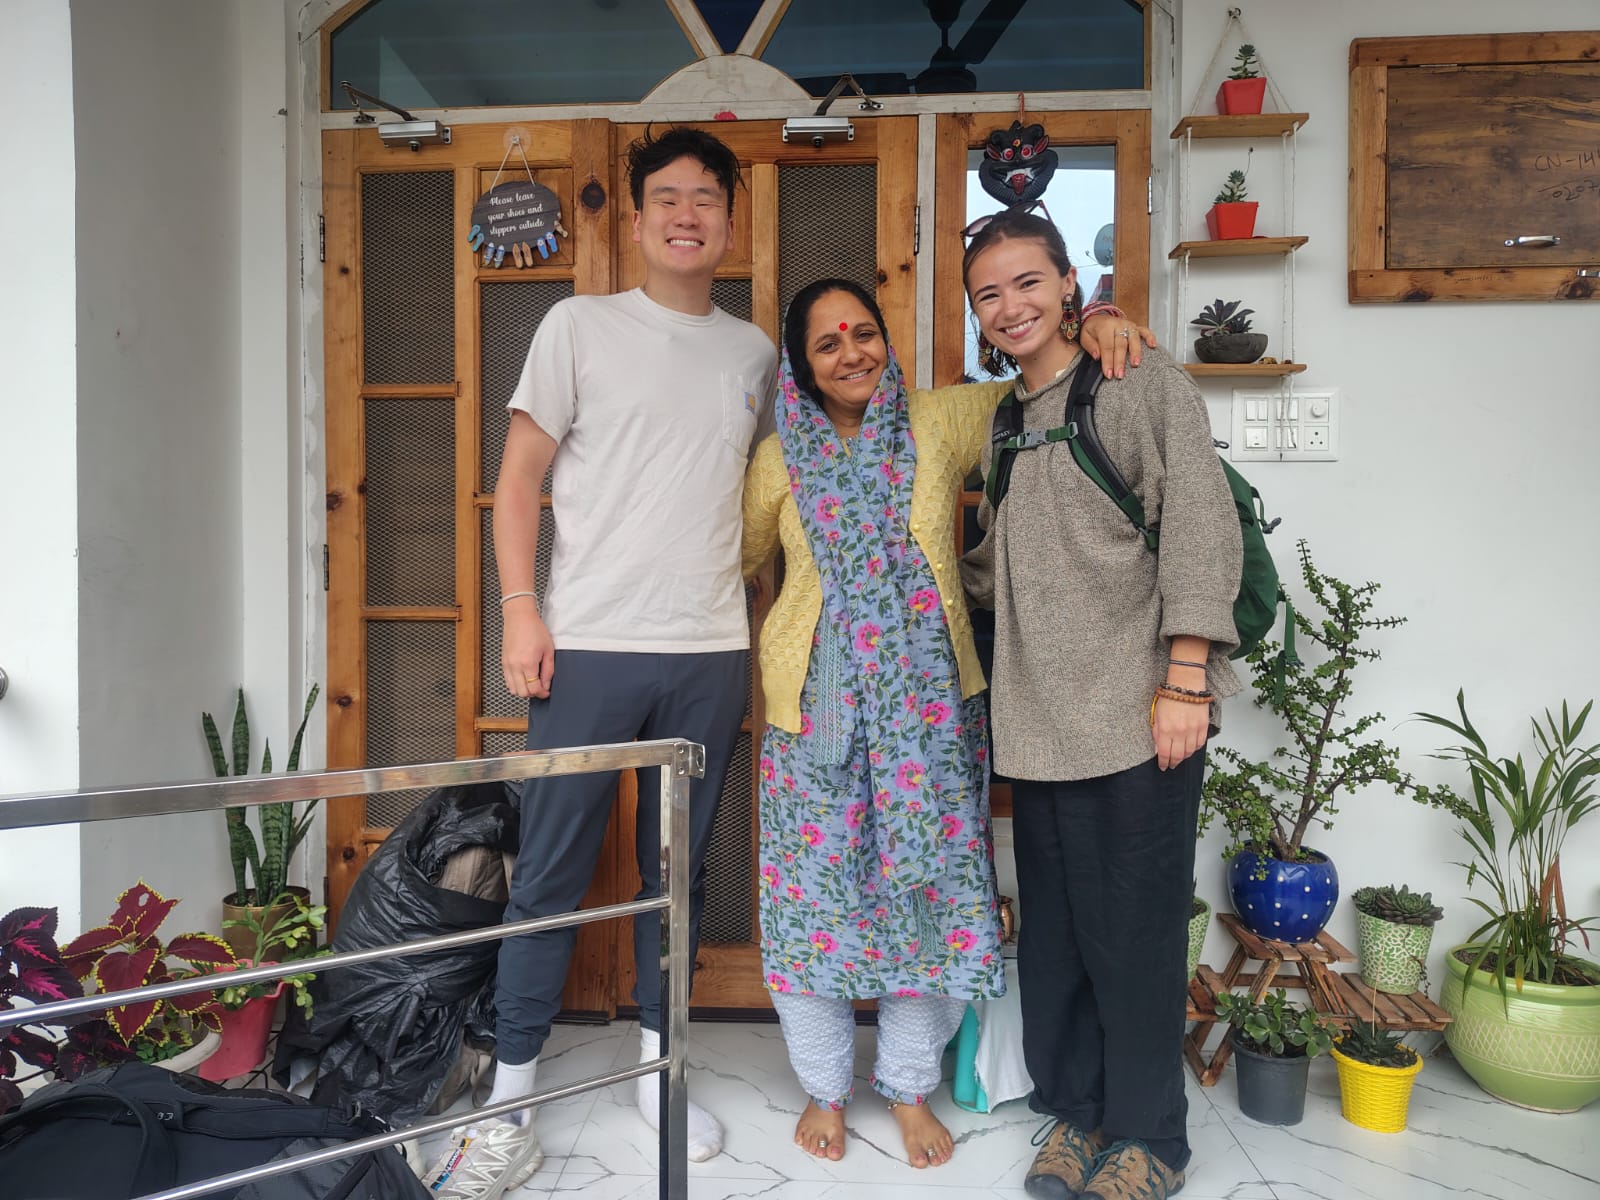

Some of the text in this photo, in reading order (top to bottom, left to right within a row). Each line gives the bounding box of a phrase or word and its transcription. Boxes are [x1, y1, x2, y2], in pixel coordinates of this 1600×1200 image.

[490, 192, 535, 206] Please leave
[1552, 179, 1600, 201] 0207
[487, 203, 543, 224] your shoes and
[489, 218, 545, 237] slippers outside
